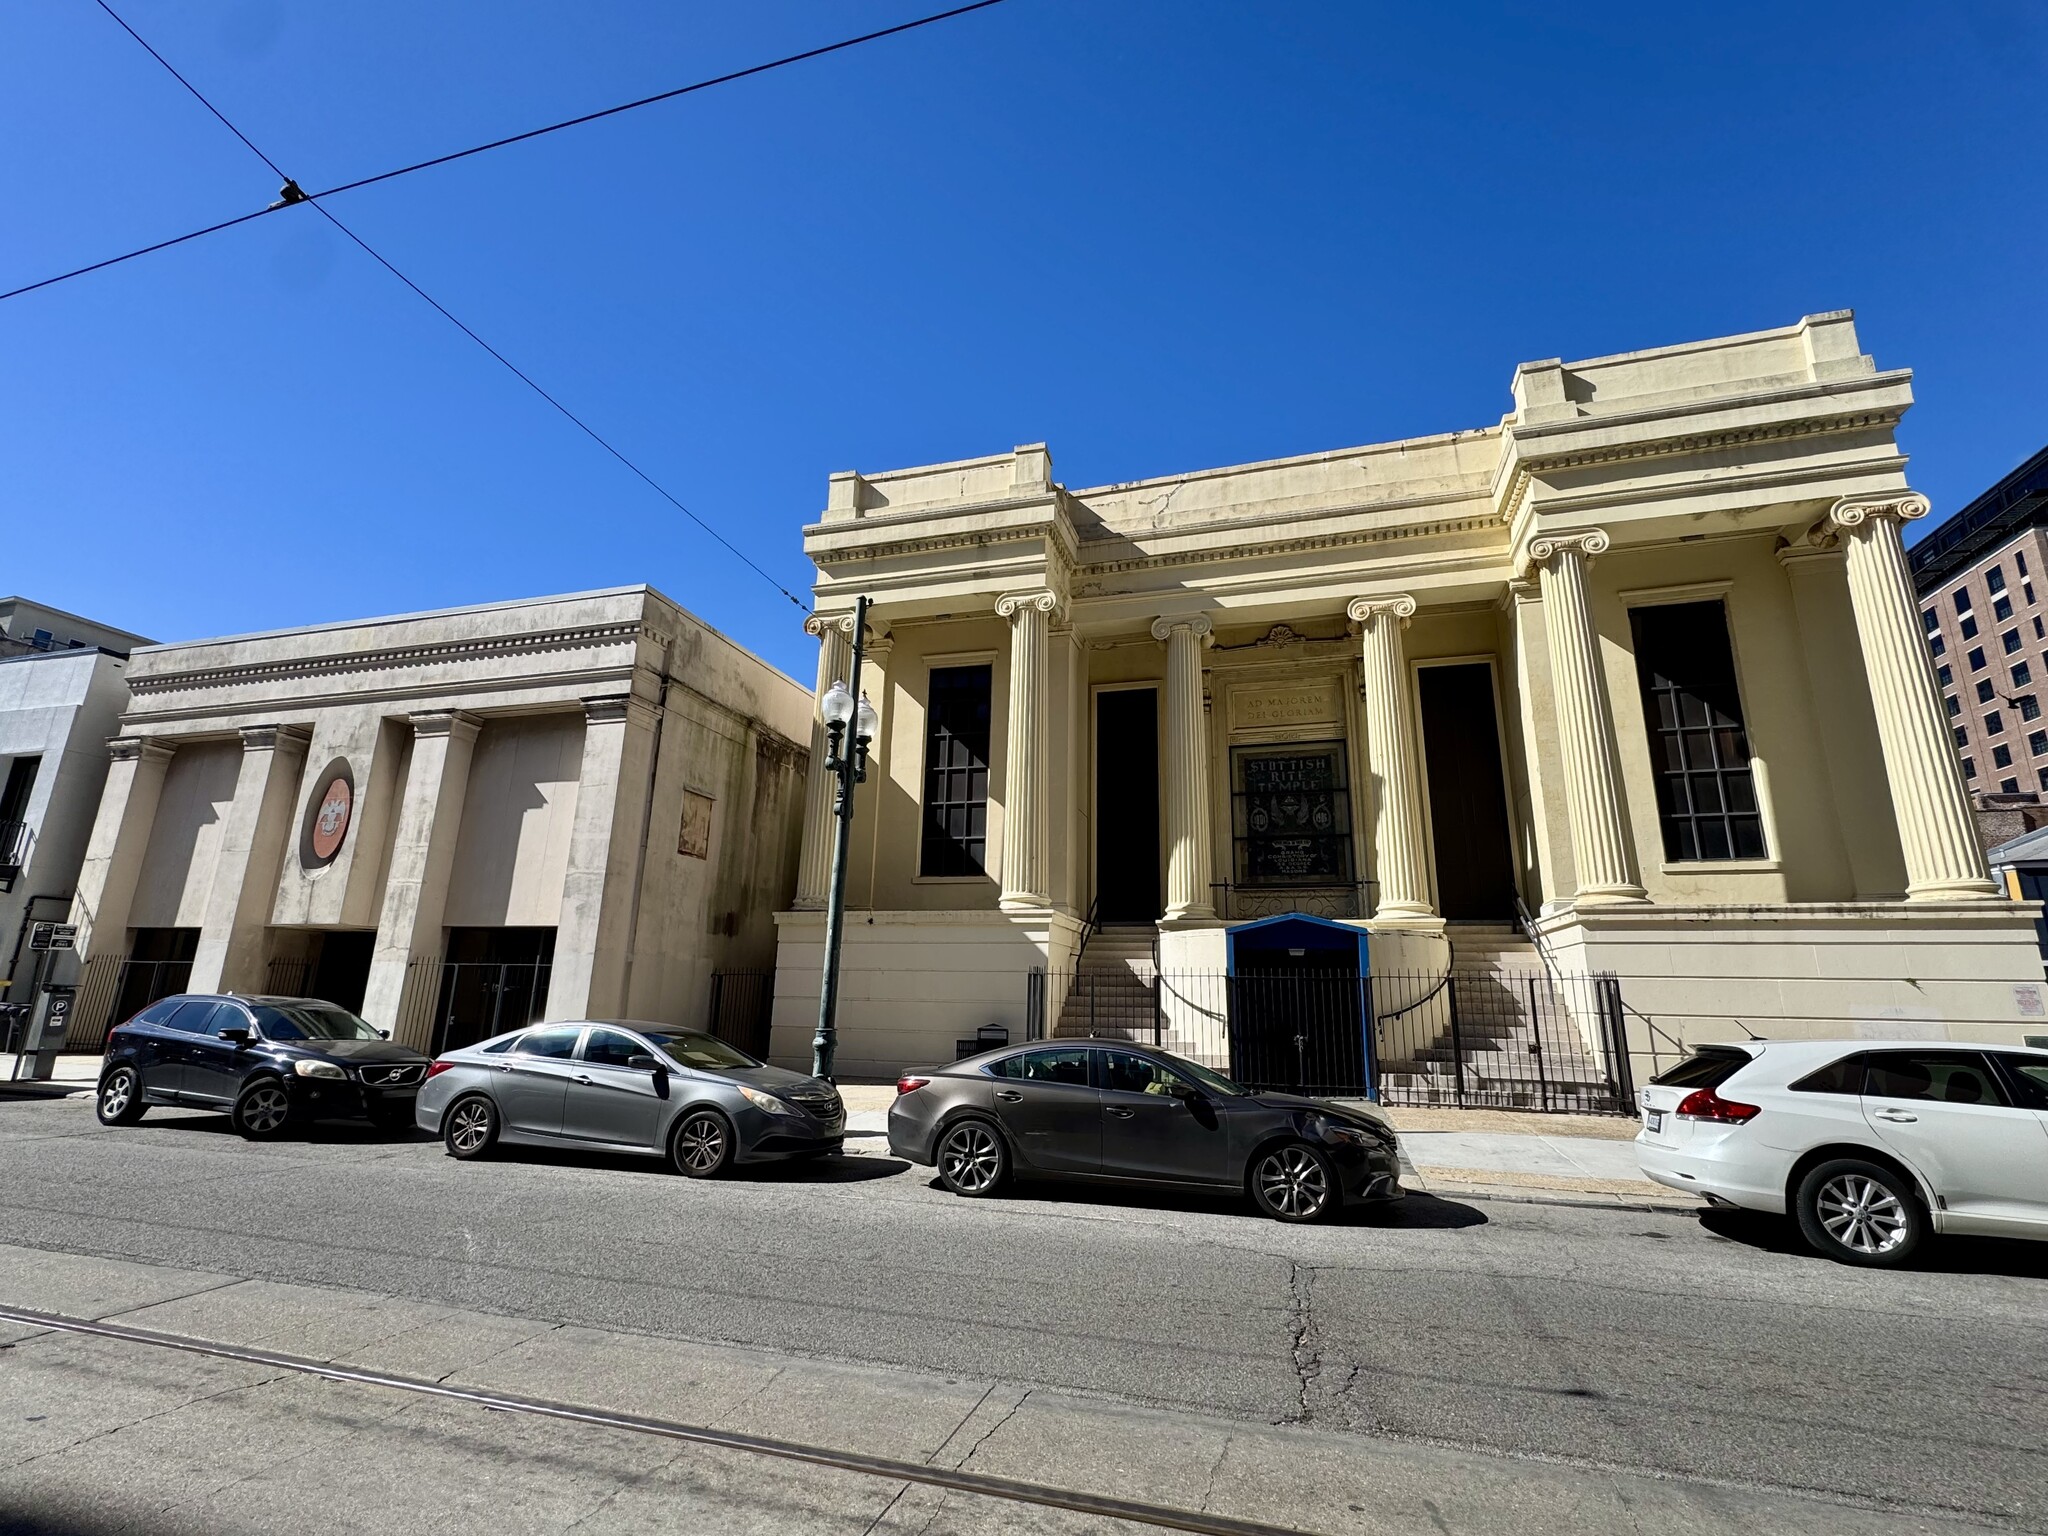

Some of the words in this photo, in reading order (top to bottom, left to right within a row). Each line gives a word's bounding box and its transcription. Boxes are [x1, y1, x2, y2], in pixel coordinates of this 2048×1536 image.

[1247, 699, 1263, 708] AD
[1268, 695, 1323, 706] MAJOREM
[1247, 711, 1266, 719] DEI
[1271, 708, 1323, 718] GLORIAM
[1250, 758, 1325, 773] SCOTTISH
[1271, 771, 1306, 782] RITE
[1257, 780, 1319, 792] TEMPLE
